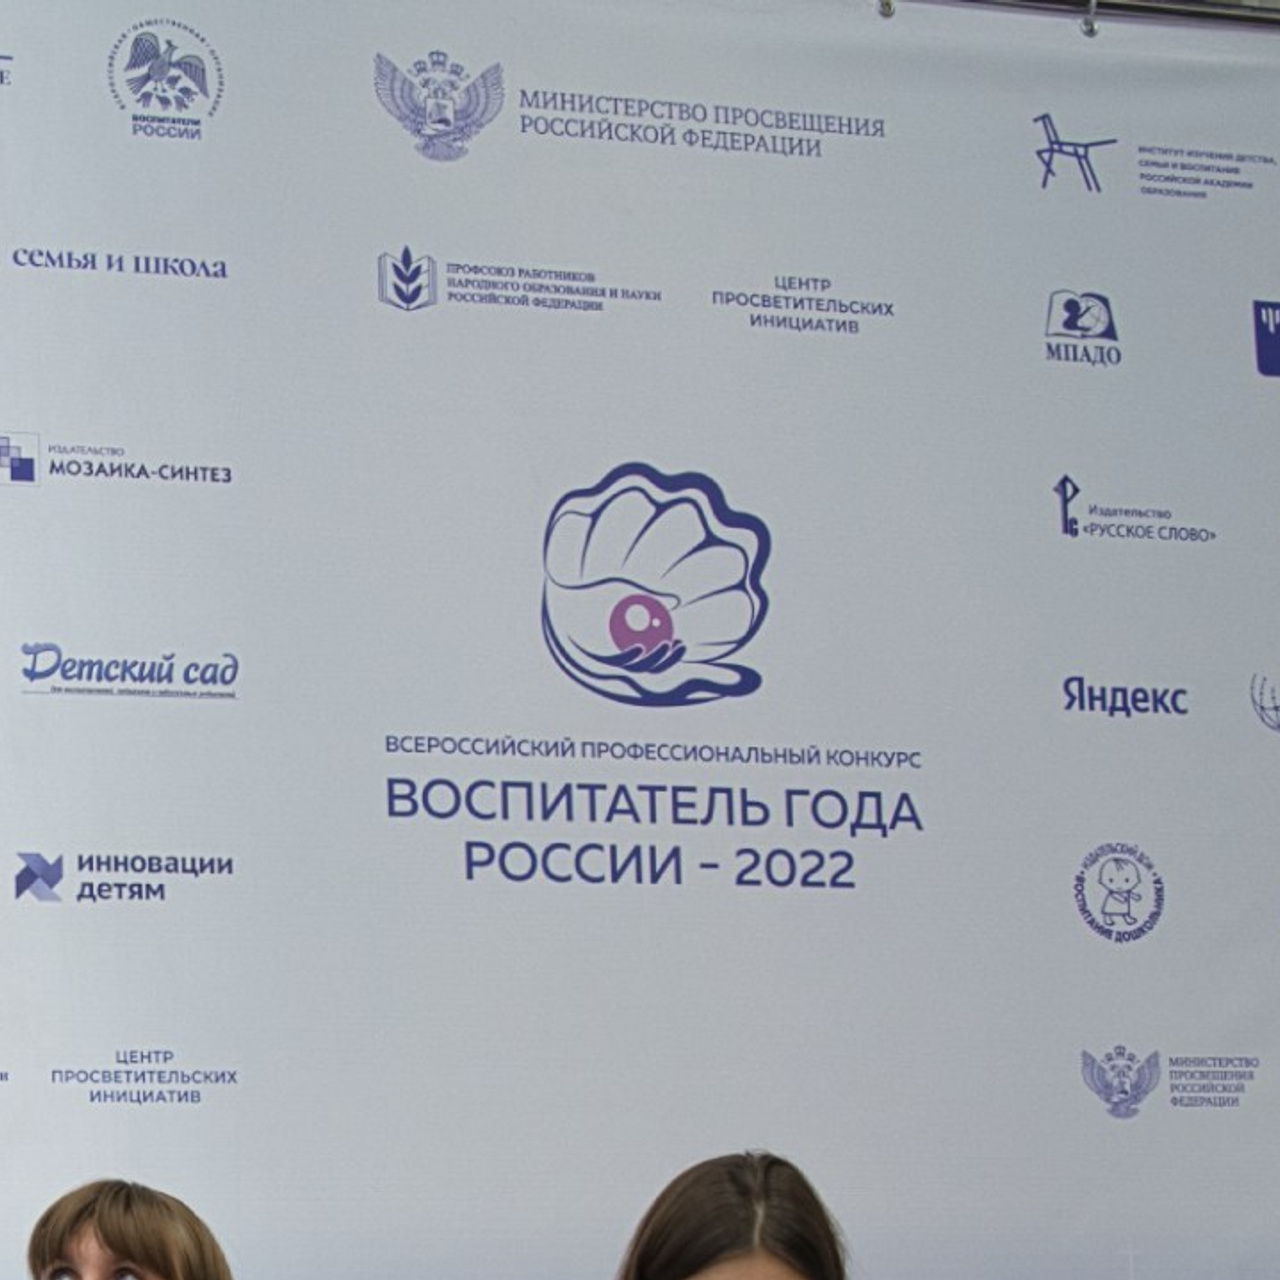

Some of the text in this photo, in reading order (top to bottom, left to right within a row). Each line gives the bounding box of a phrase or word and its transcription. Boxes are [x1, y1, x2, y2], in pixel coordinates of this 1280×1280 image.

[519, 90, 885, 138] МИНИСТЕРСТВО ПРОСВЕЩЕНИЯ
[132, 123, 202, 140] РОССИИ
[520, 115, 823, 159] РОССИЙСКОЙ ФЕДЕРАЦИИ
[12, 246, 98, 271] семья
[133, 255, 228, 280] школа
[446, 262, 596, 283] ПРОФСОЮЗ РАБОТНИКОВ
[447, 277, 520, 292] НАРОДНОГО
[523, 282, 607, 298] ОБРАЗОВАНИЯ
[620, 289, 662, 301] НАУКИ
[774, 275, 832, 294] ЦЕНТР
[448, 291, 530, 307] РОССИЙСКОЙ
[712, 290, 895, 318] ПРОСВЕТИТЕЛЬСКИХ
[749, 313, 860, 335] ИНИЦИАТИВ
[1045, 342, 1122, 367] МПАДО
[49, 459, 233, 484] МОЗАИКА-СИНТЕЗ
[1088, 504, 1172, 520] Издательство
[21, 642, 240, 686] Детский сад
[1063, 676, 1188, 718] Яндекс
[385, 735, 922, 769] ВСЕРОССИЙСКИЙ ПРОФЕССИОНАЛЬНЫЙ КОНКУРС
[386, 777, 924, 838] ВОСПИТАТЕЛЬ ГОДА
[77, 853, 234, 876] инновации
[464, 840, 683, 885] РОССИИ
[734, 847, 856, 889] 2022
[77, 879, 166, 902] детям
[115, 1049, 174, 1067] ЦЕНТР
[51, 1069, 238, 1087] ПРОСВЕТИТЕЛЬСКИХ
[89, 1089, 201, 1105] ИНИЦИАТИВ
